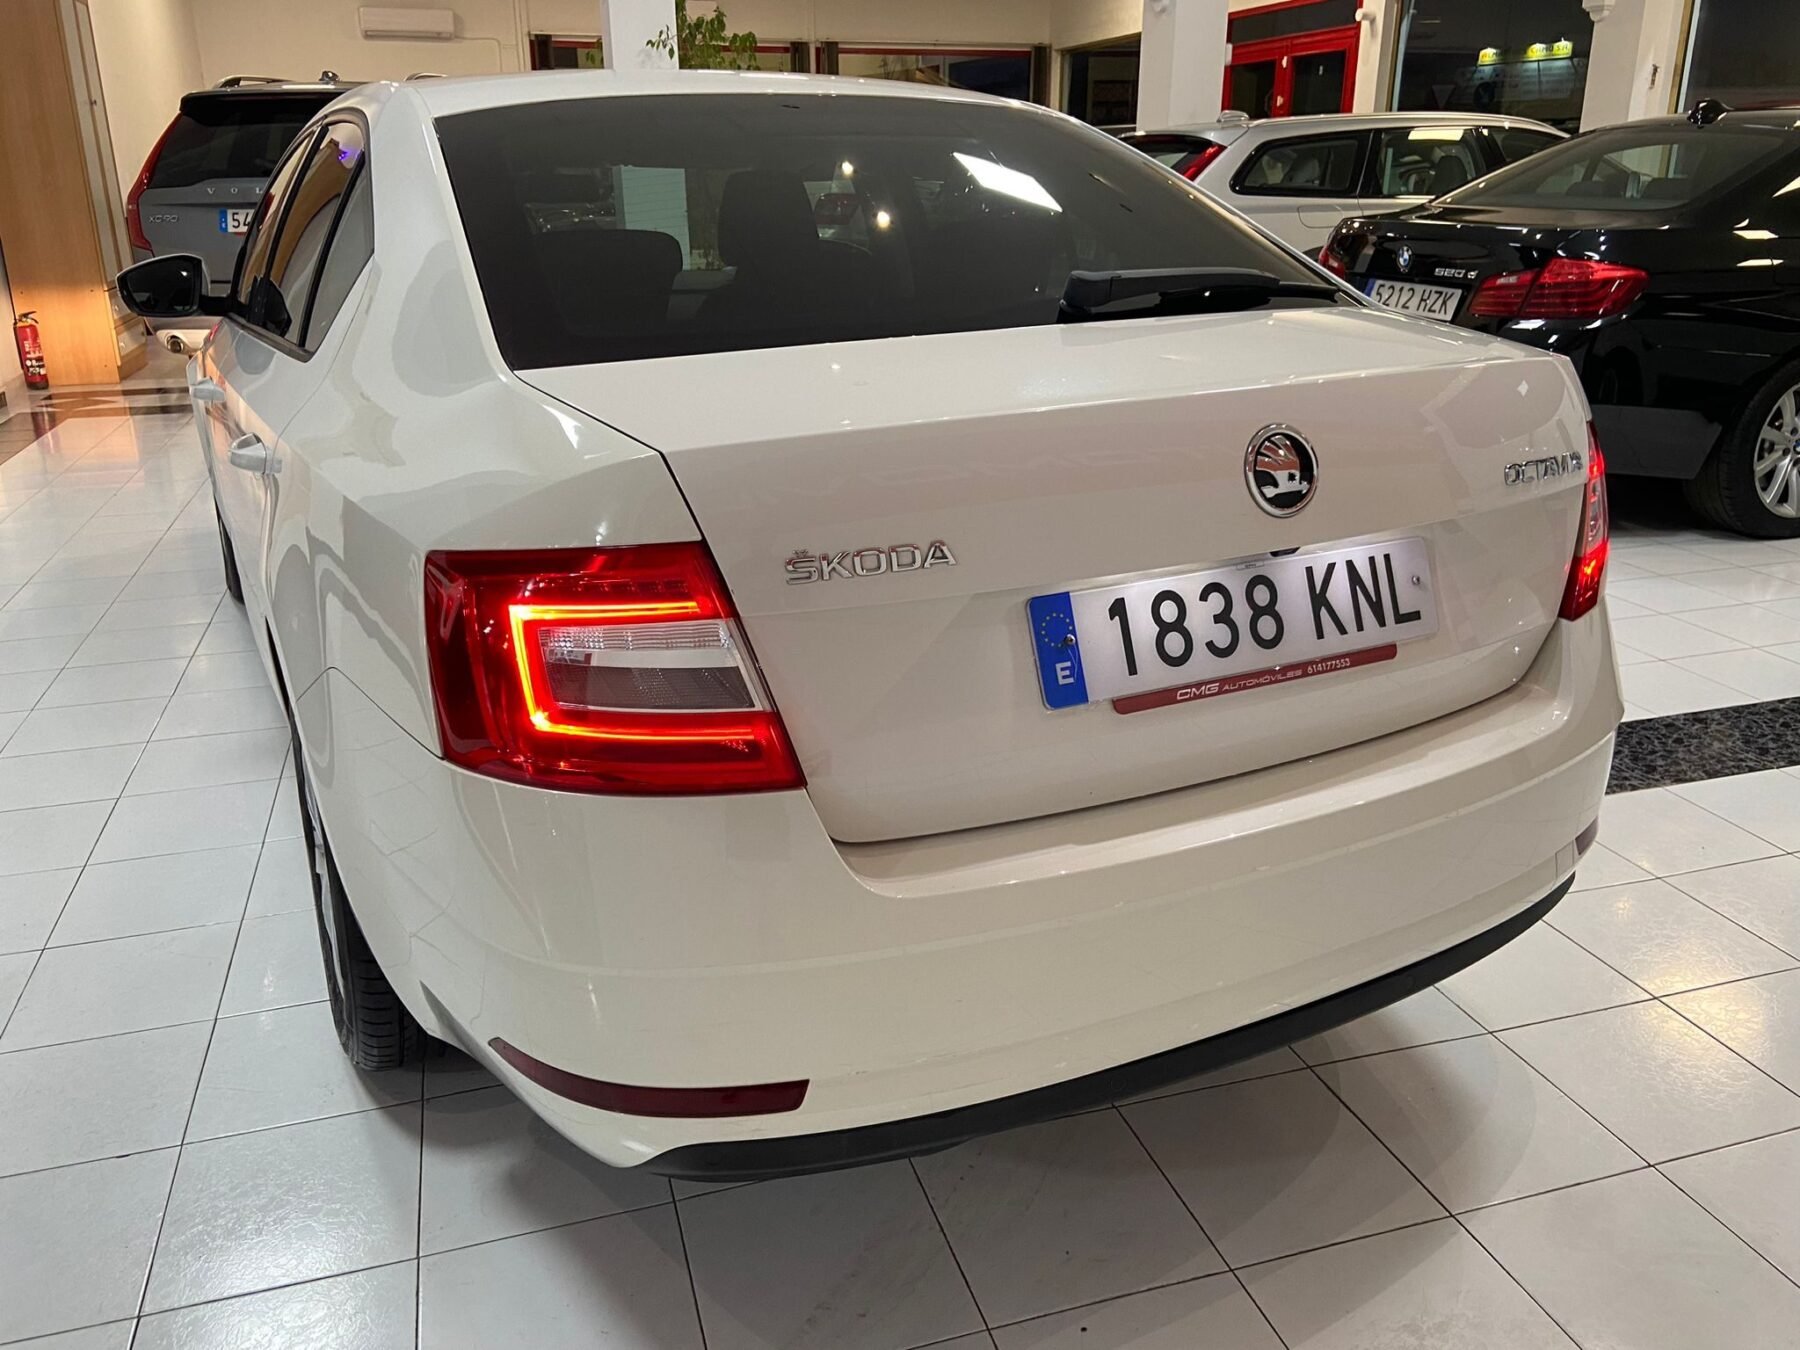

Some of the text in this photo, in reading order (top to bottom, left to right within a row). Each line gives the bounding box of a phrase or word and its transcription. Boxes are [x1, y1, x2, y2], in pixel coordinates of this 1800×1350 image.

[231, 211, 251, 229] 54
[1375, 284, 1455, 315] 5212 HZK
[785, 540, 957, 585] ŠKODA
[1108, 553, 1422, 677] 1838 KNL
[1055, 661, 1076, 686] E
[1176, 682, 1219, 701] CMG
[1307, 657, 1351, 674] 614177553
